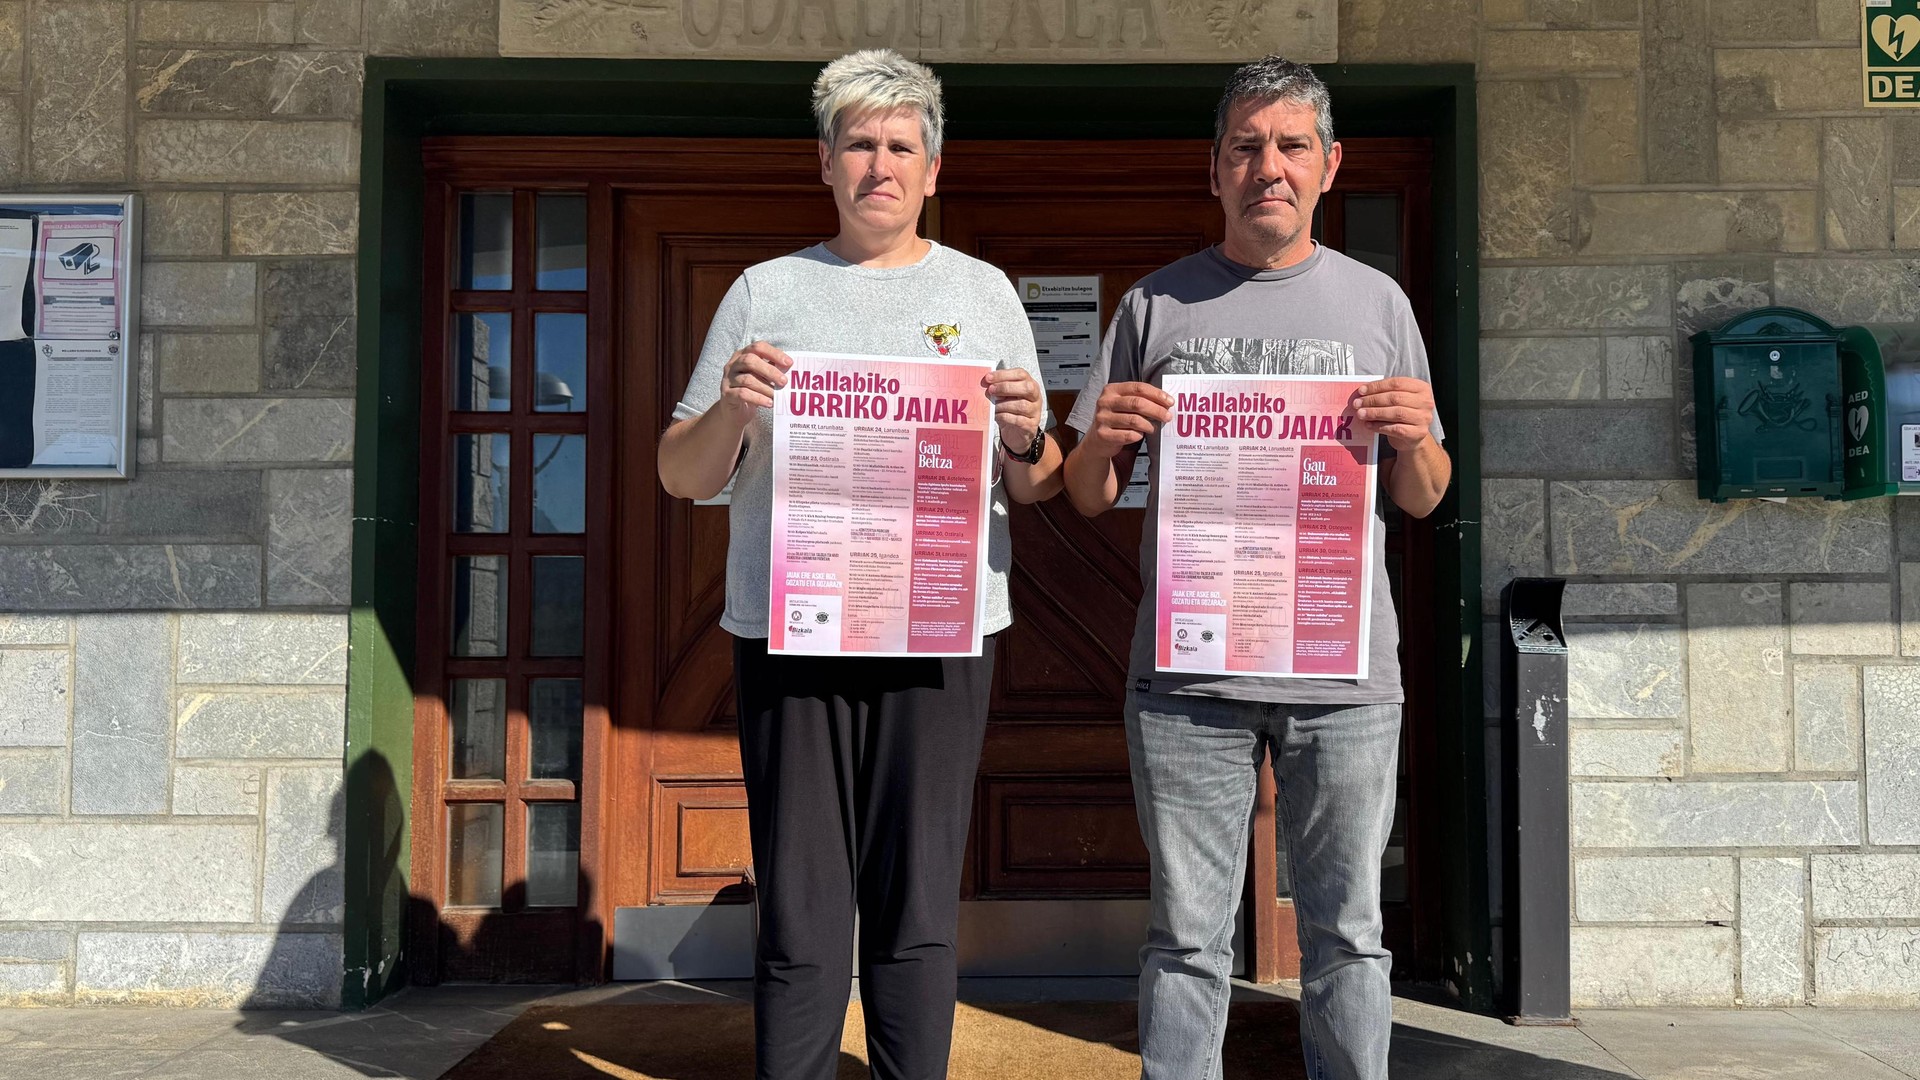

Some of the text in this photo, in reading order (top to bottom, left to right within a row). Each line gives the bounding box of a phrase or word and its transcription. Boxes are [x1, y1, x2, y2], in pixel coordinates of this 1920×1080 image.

[1872, 75, 1920, 98] DE
[790, 370, 900, 395] Mallabiko
[1177, 392, 1286, 413] Mallabiko
[1848, 390, 1869, 404] AED
[789, 392, 969, 425] URRIKO JAIAK
[1176, 414, 1354, 440] URRIKO JAIAK
[919, 440, 941, 455] Gau
[1848, 445, 1870, 458] DEA
[918, 454, 953, 469] Beltza
[1303, 457, 1326, 472] Gau
[1302, 472, 1337, 486] Beltza
